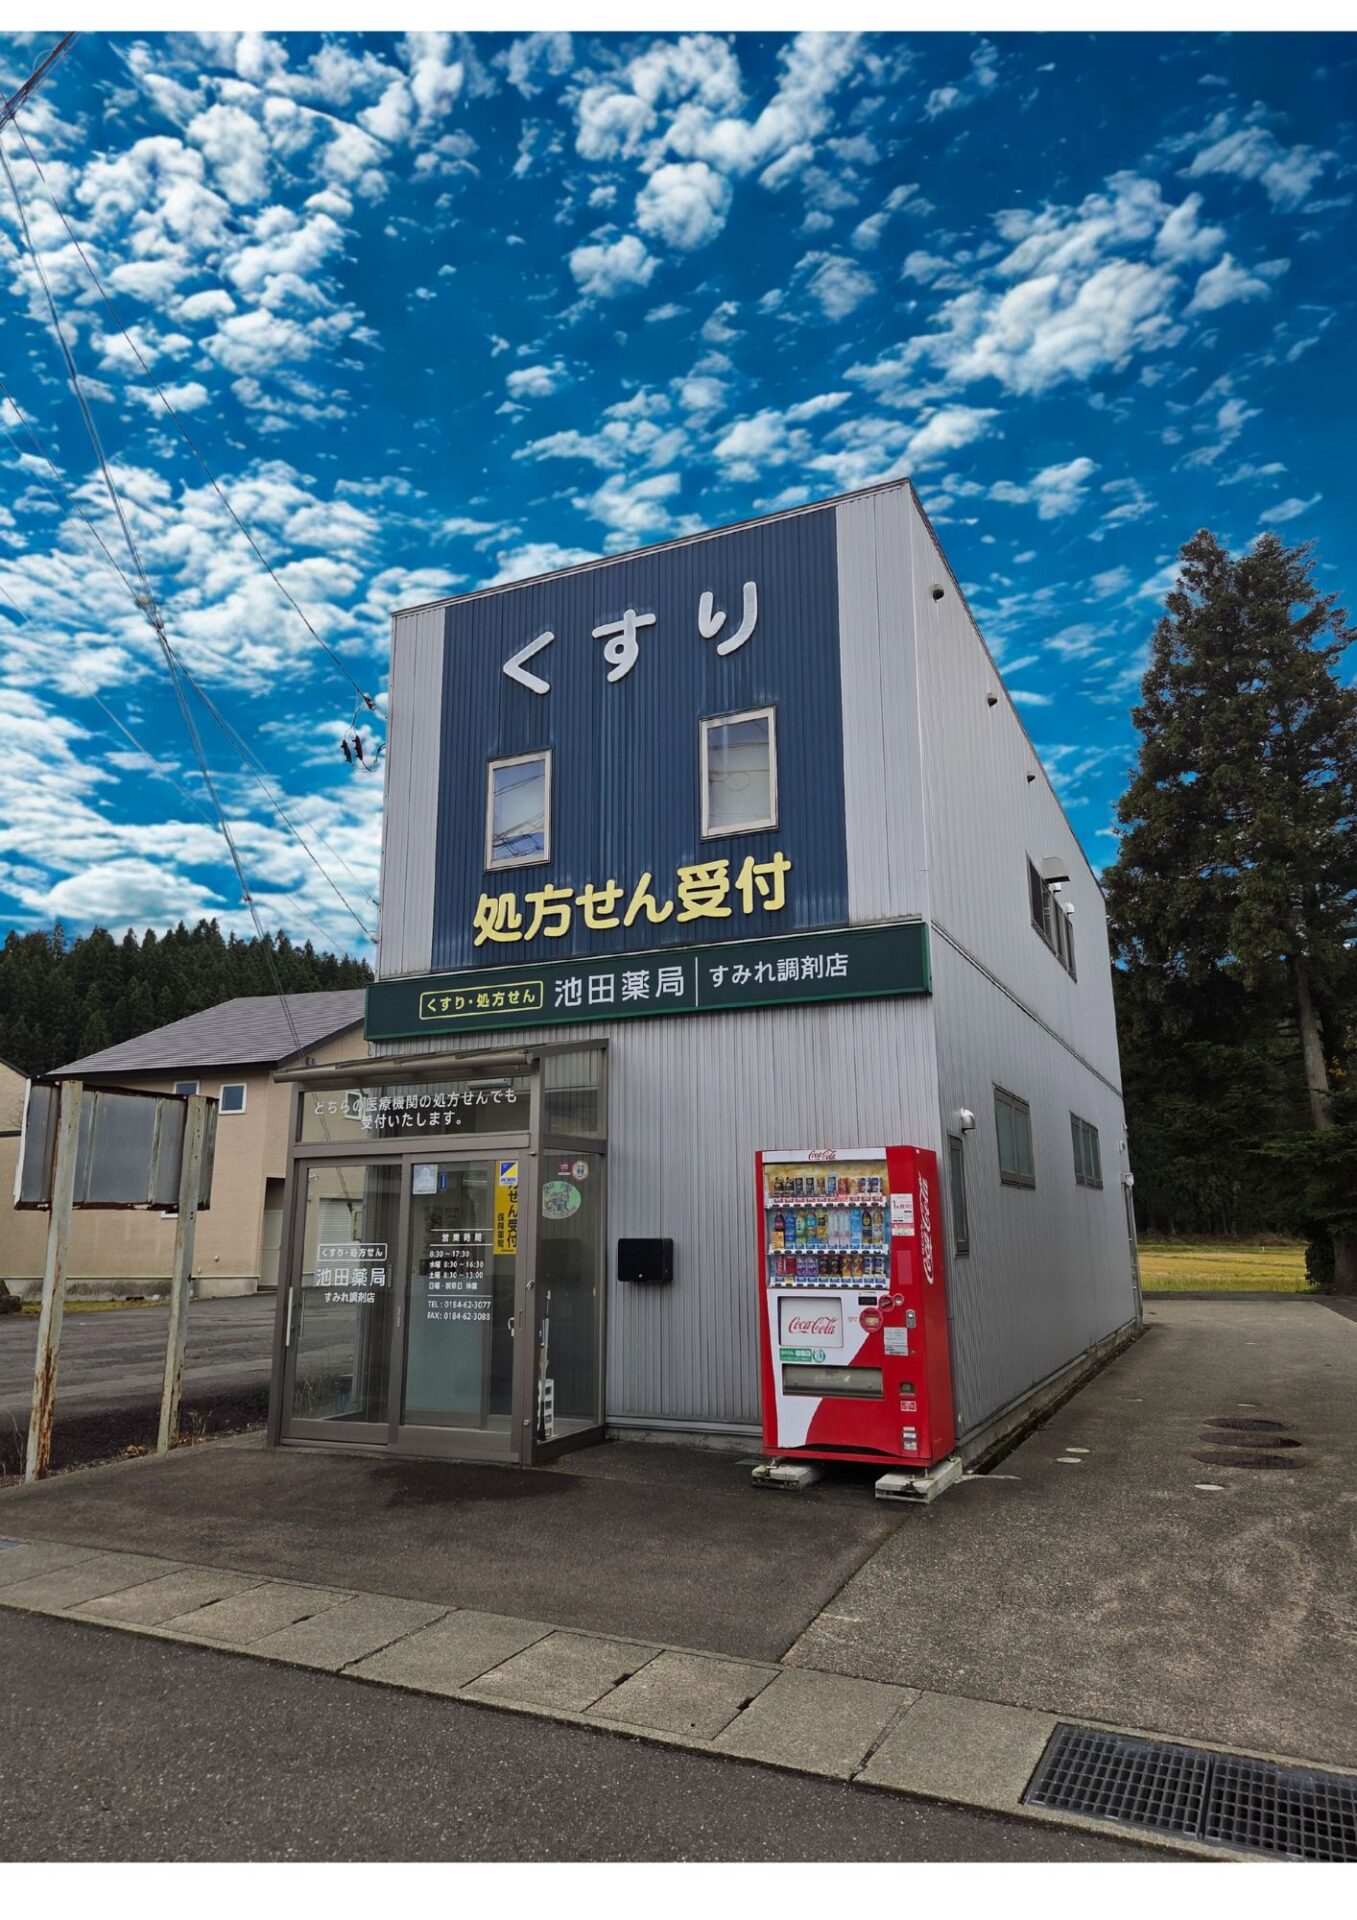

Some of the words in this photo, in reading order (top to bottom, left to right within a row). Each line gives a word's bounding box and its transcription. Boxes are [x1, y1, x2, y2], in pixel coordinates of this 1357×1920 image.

[502, 580, 759, 696] くすり
[472, 850, 793, 947] 処方せん受付
[708, 952, 849, 988] すみれ調剤店
[554, 965, 685, 1008] 池田薬局
[426, 989, 537, 1013] くすり・処方せん
[313, 1088, 518, 1115] どちらの医療機関の処方せんでも
[361, 1110, 463, 1131] 受付いたします。
[313, 1267, 387, 1288] 池田薬局
[323, 1291, 376, 1304] すみれ調剤店
[788, 1316, 839, 1335] Coca-Cola
